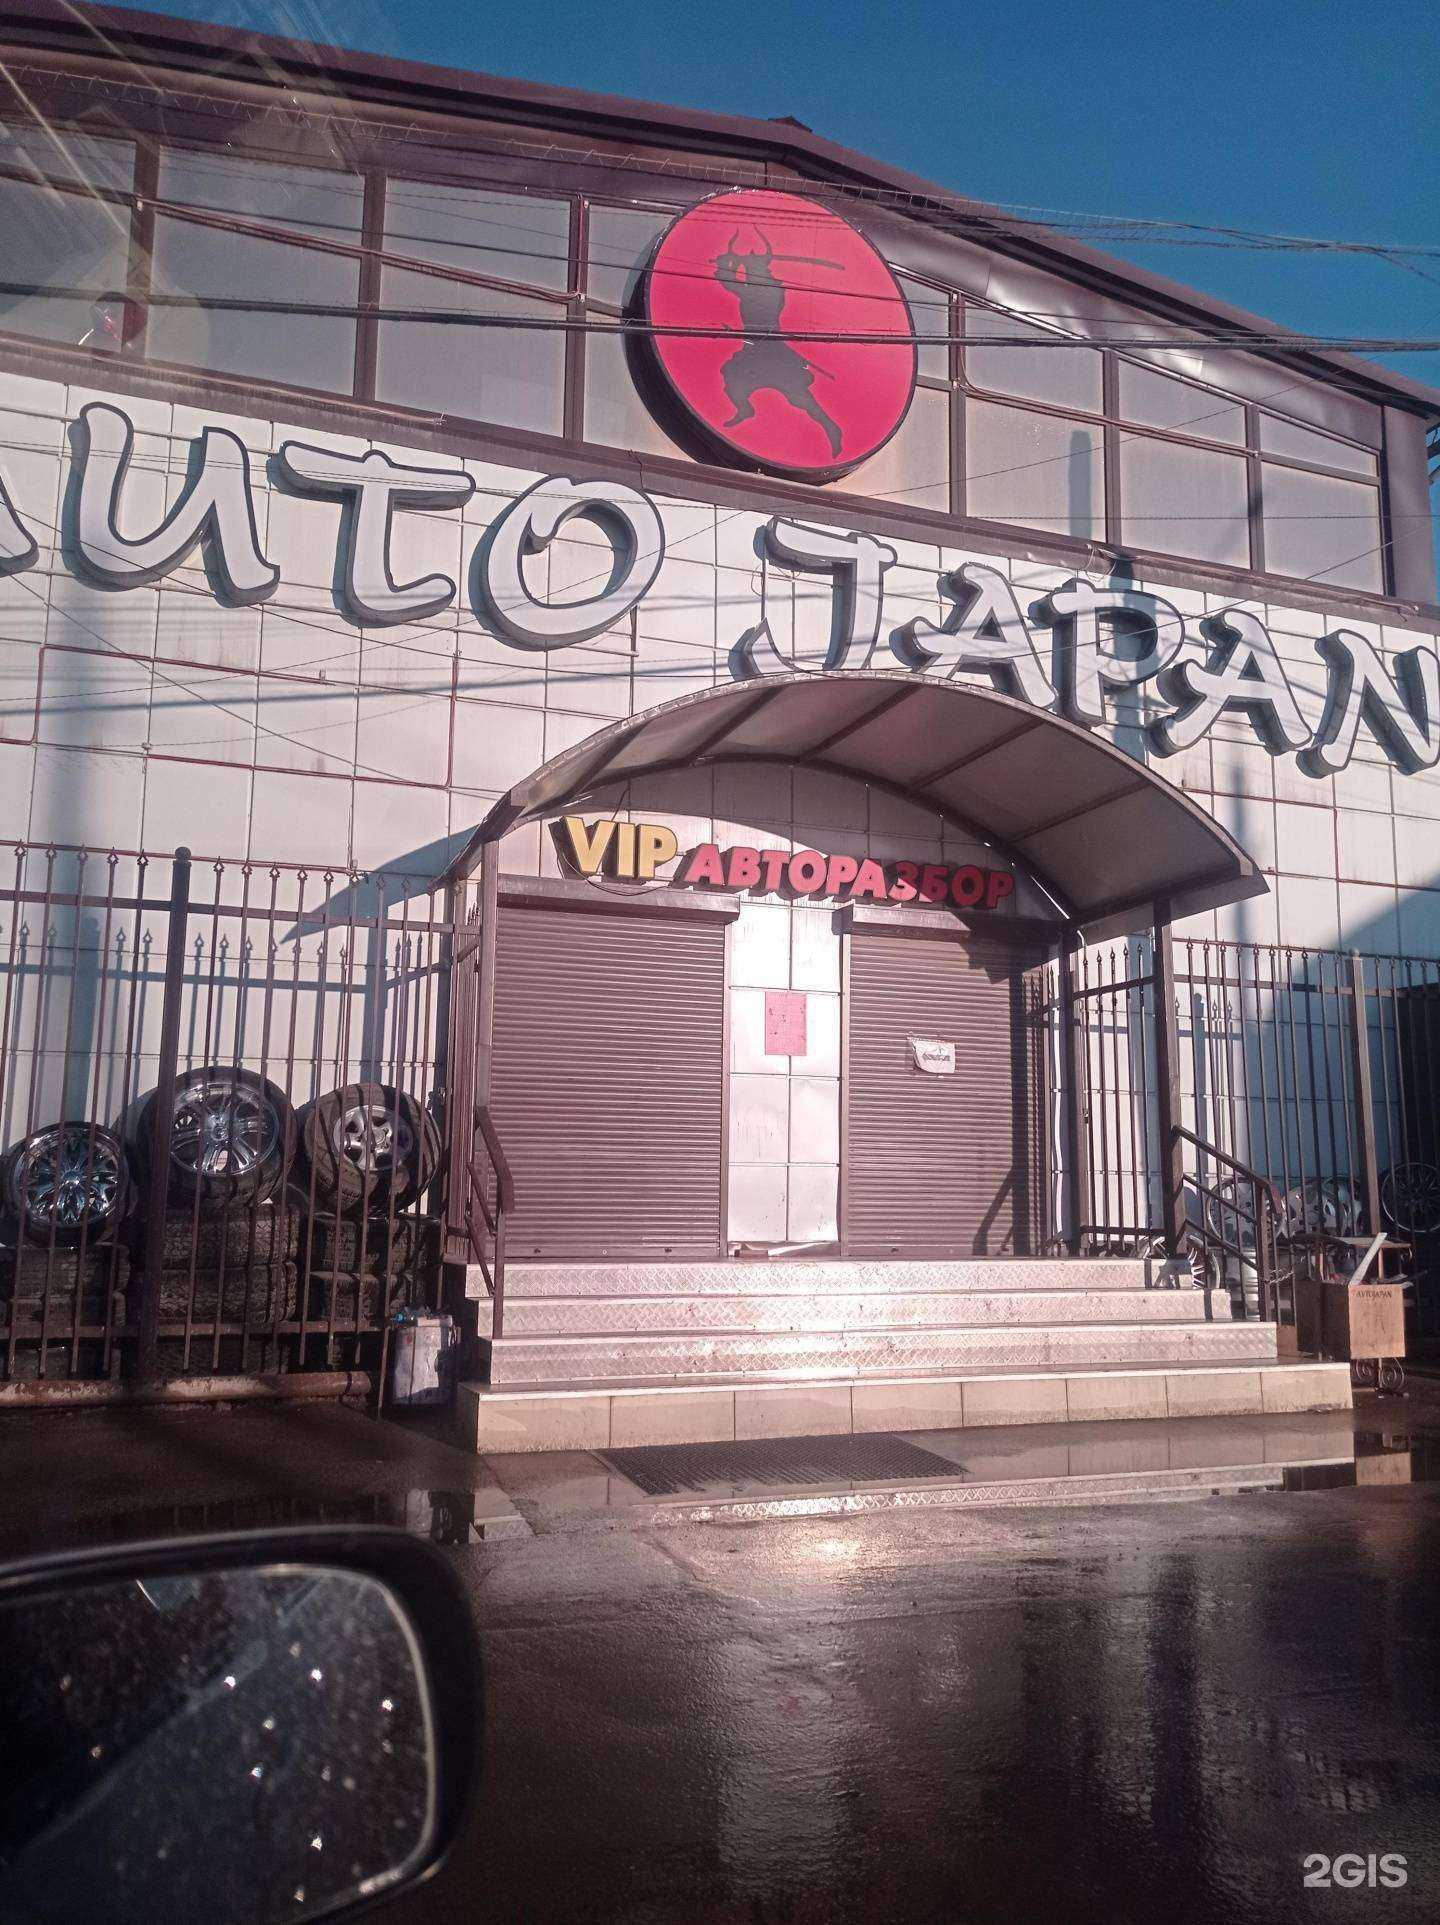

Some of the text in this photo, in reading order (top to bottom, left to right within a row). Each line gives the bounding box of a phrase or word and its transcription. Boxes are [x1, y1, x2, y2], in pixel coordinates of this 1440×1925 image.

[728, 515, 1440, 778] JAPAN
[550, 815, 1014, 909] VIP АВТОРАЗБОР
